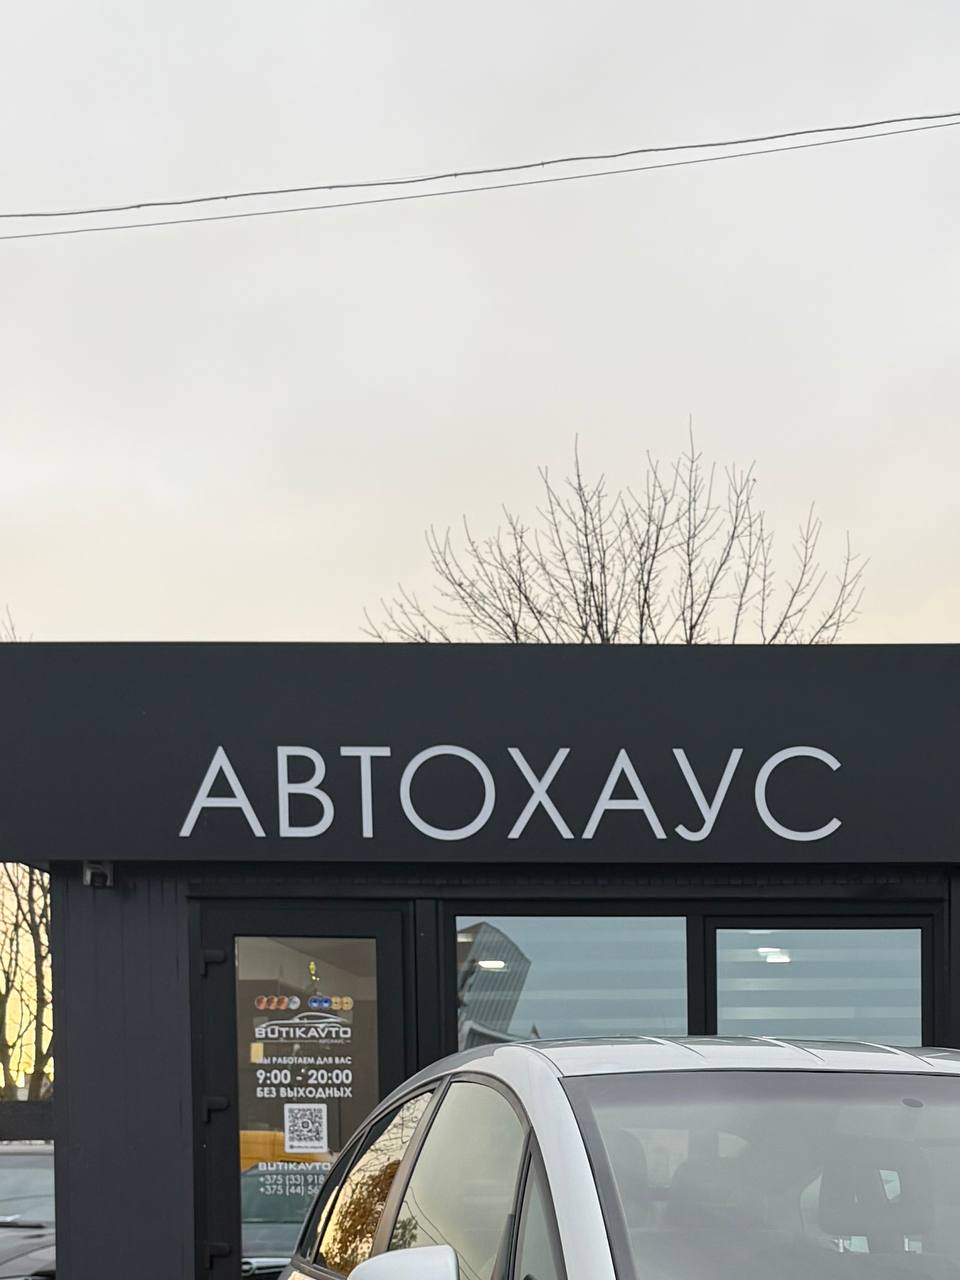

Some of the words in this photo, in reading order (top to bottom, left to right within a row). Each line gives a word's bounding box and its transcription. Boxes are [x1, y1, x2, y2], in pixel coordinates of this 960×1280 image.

[179, 745, 842, 841] АВТОХАУС
[255, 1027, 352, 1038] BUTIKAVTO
[335, 1056, 352, 1064] ВАС
[256, 1069, 291, 1084] 9:00
[307, 1069, 353, 1084] 20:00
[256, 1087, 276, 1098] БЕЗ
[280, 1087, 353, 1098] ВЫХОДНЫХ
[258, 1162, 331, 1171] BUTIKAVTO
[259, 1175, 283, 1185] +375
[286, 1174, 304, 1187] (33)
[259, 1185, 283, 1195] +375
[286, 1185, 304, 1197] (44)
